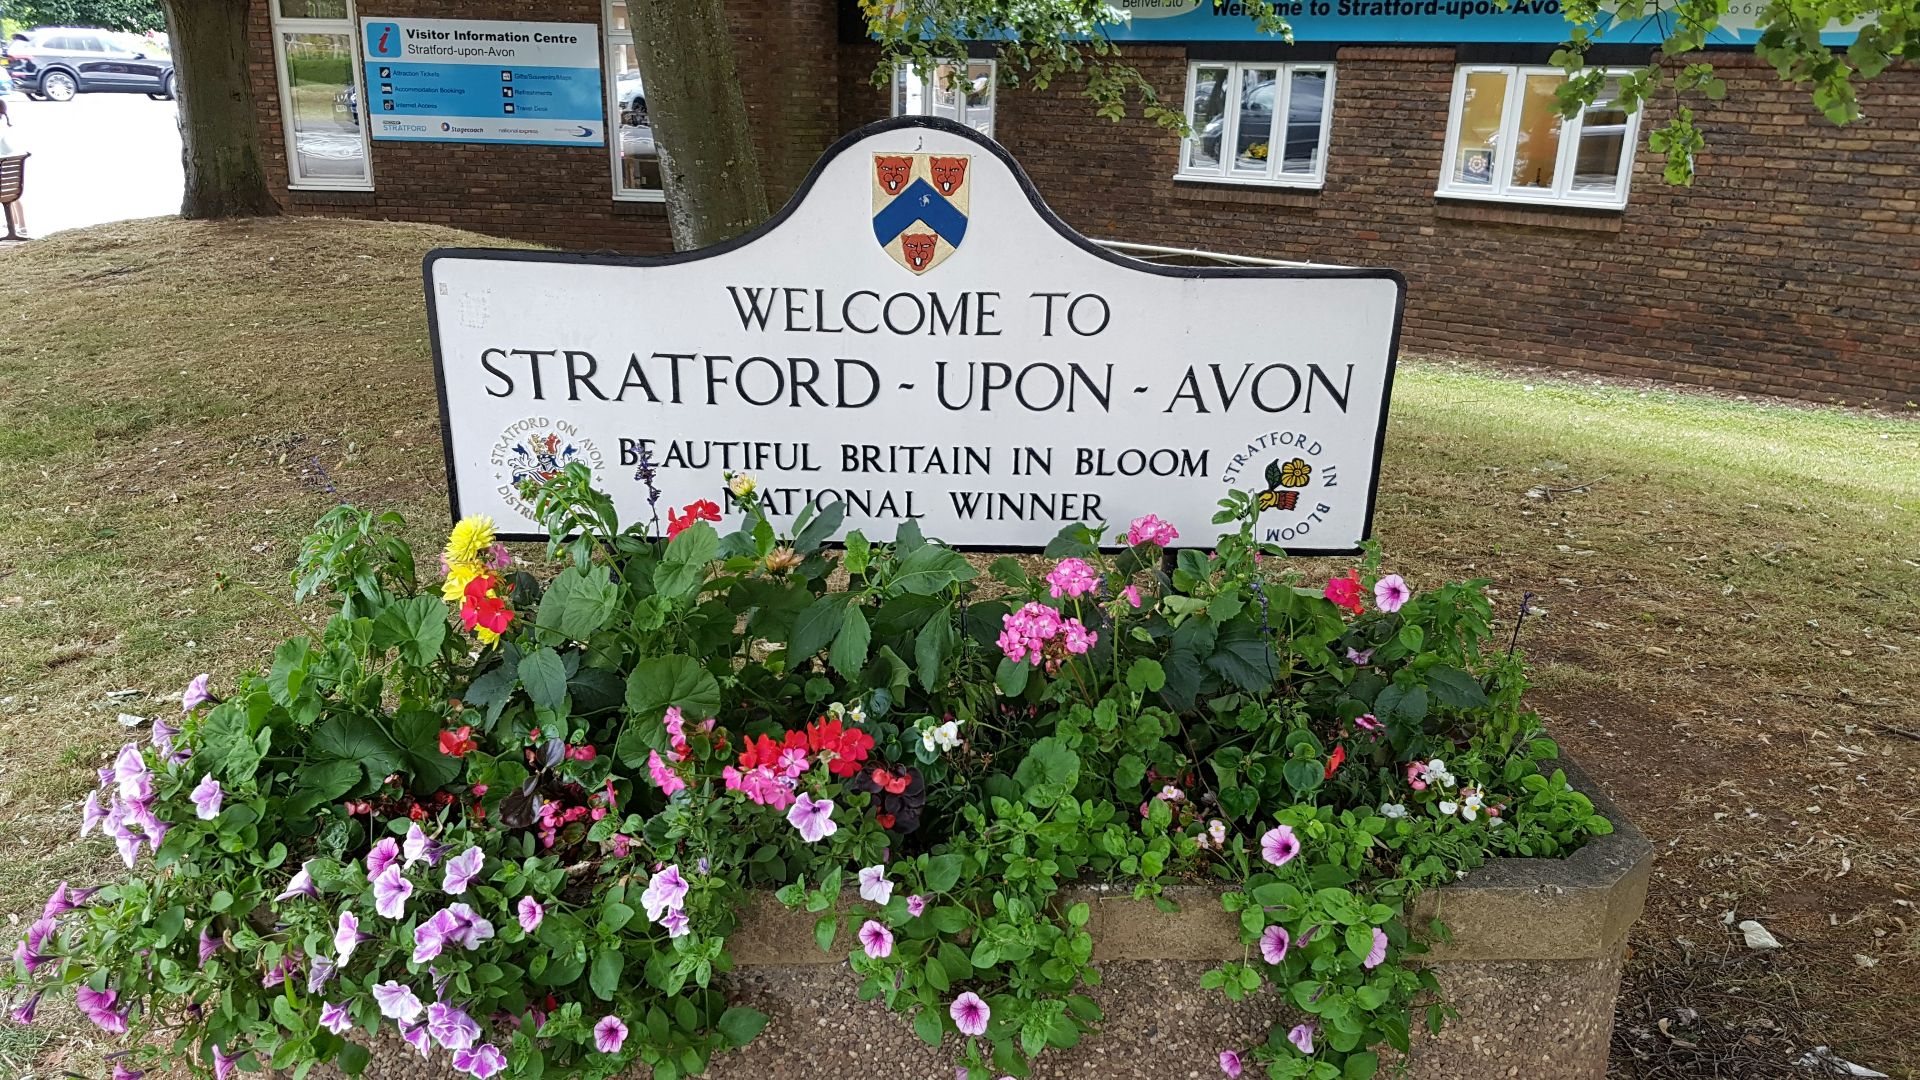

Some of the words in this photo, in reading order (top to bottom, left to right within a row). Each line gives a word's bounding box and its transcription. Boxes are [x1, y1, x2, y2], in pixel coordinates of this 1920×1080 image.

[1309, 0, 1330, 16] to
[406, 28, 450, 41] Visitor
[454, 30, 530, 43] Information
[533, 32, 578, 45] Centre
[407, 44, 515, 58] Stratford-upon-Avon
[395, 86, 439, 94] Accommodation
[440, 87, 465, 95] Bookings
[726, 286, 1002, 336] WELCOME
[1029, 292, 1111, 337] TO
[481, 347, 881, 409] STRATFORD
[935, 361, 1115, 413] UPON
[1162, 362, 1355, 414] AVON
[491, 417, 550, 466] STRATFORD
[556, 420, 578, 437] ON
[579, 438, 606, 471] AVON
[618, 437, 822, 471] BEAUTIFUL
[840, 444, 991, 475] BRITAIN
[1012, 446, 1053, 476] IN
[1075, 447, 1210, 478] BLOOM
[1222, 431, 1322, 484] STRATFORD
[1321, 465, 1338, 487] IN
[948, 491, 1107, 521] WINNER
[1265, 502, 1331, 542] BLOOM
